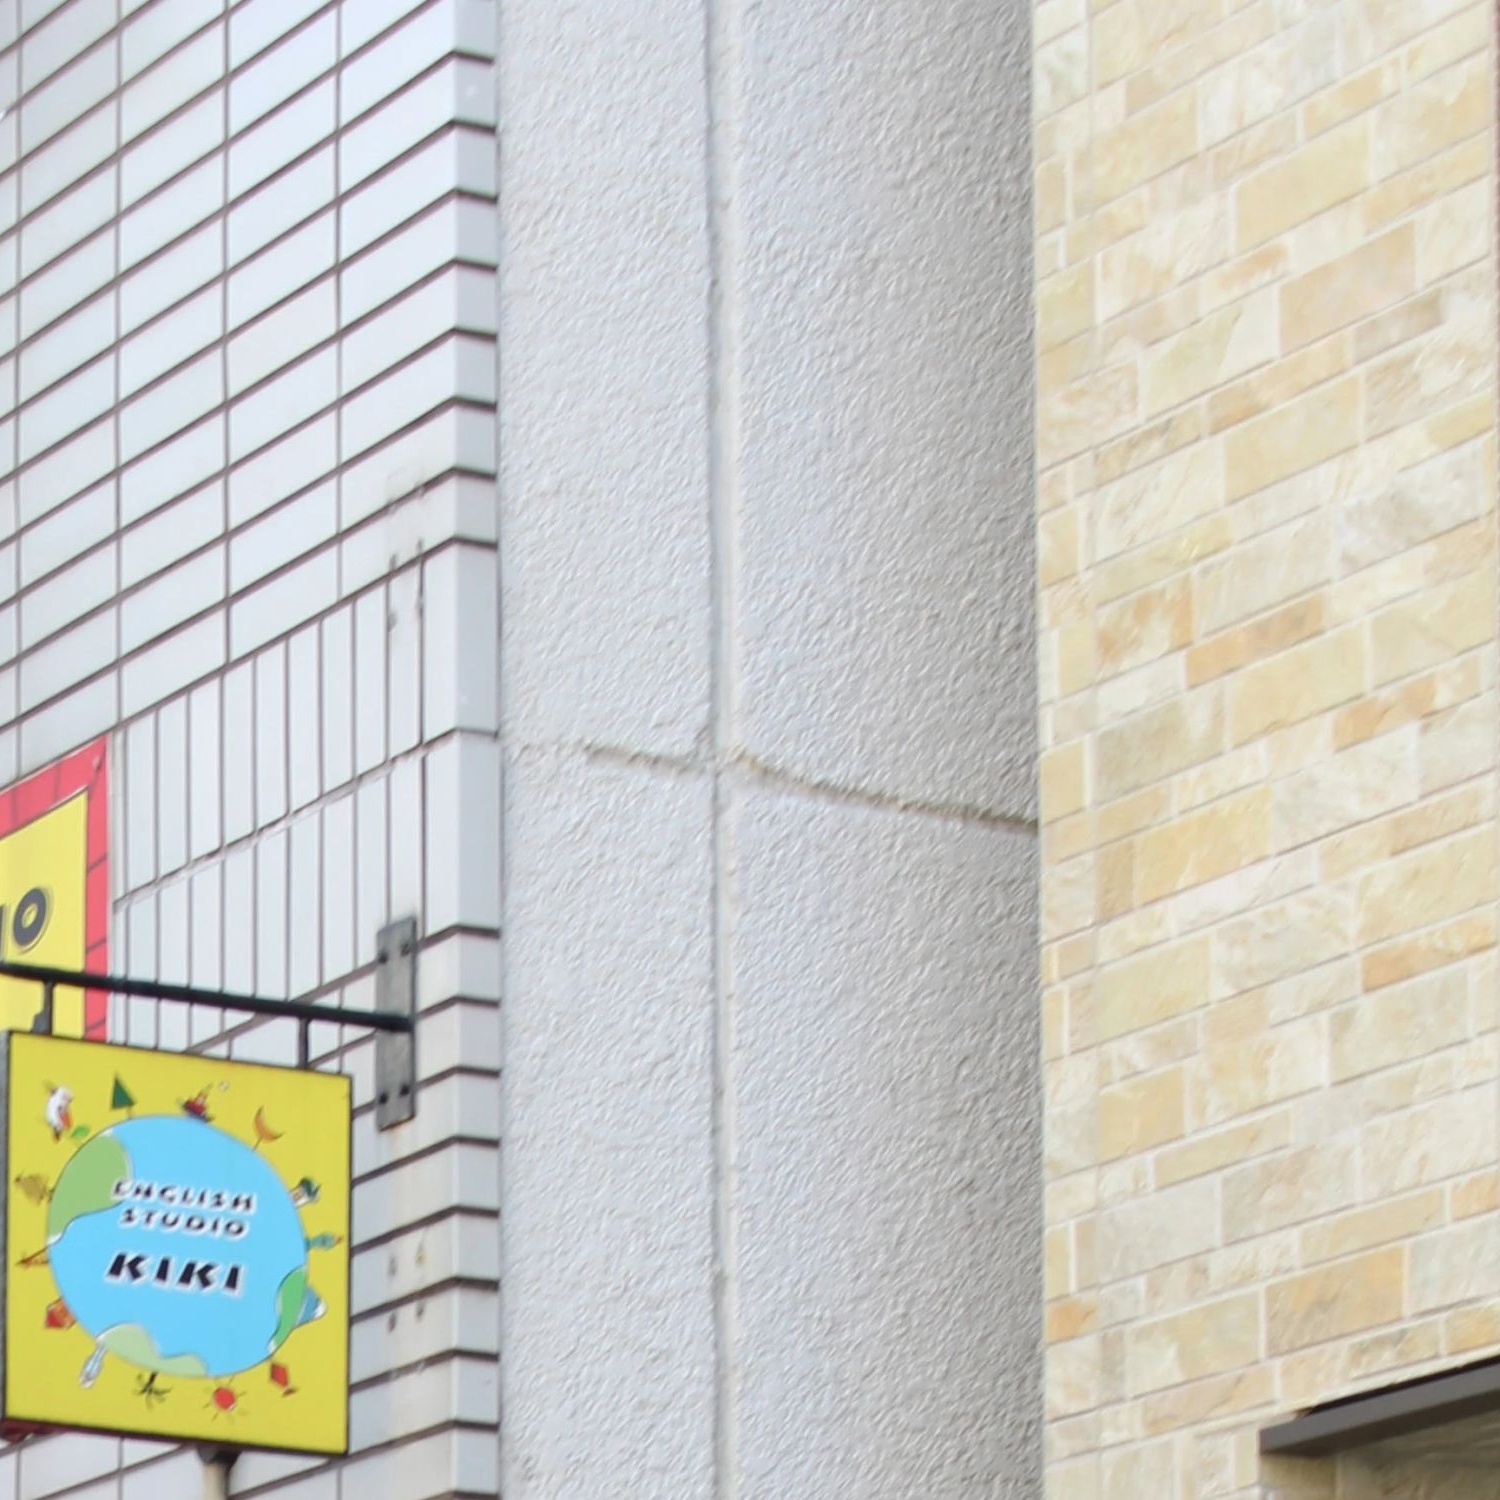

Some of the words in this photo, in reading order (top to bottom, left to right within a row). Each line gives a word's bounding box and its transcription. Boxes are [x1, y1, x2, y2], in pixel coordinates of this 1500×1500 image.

[112, 1180, 257, 1214] ENGLISH
[120, 1207, 250, 1238] STUDIO
[106, 1252, 247, 1297] KIKI
